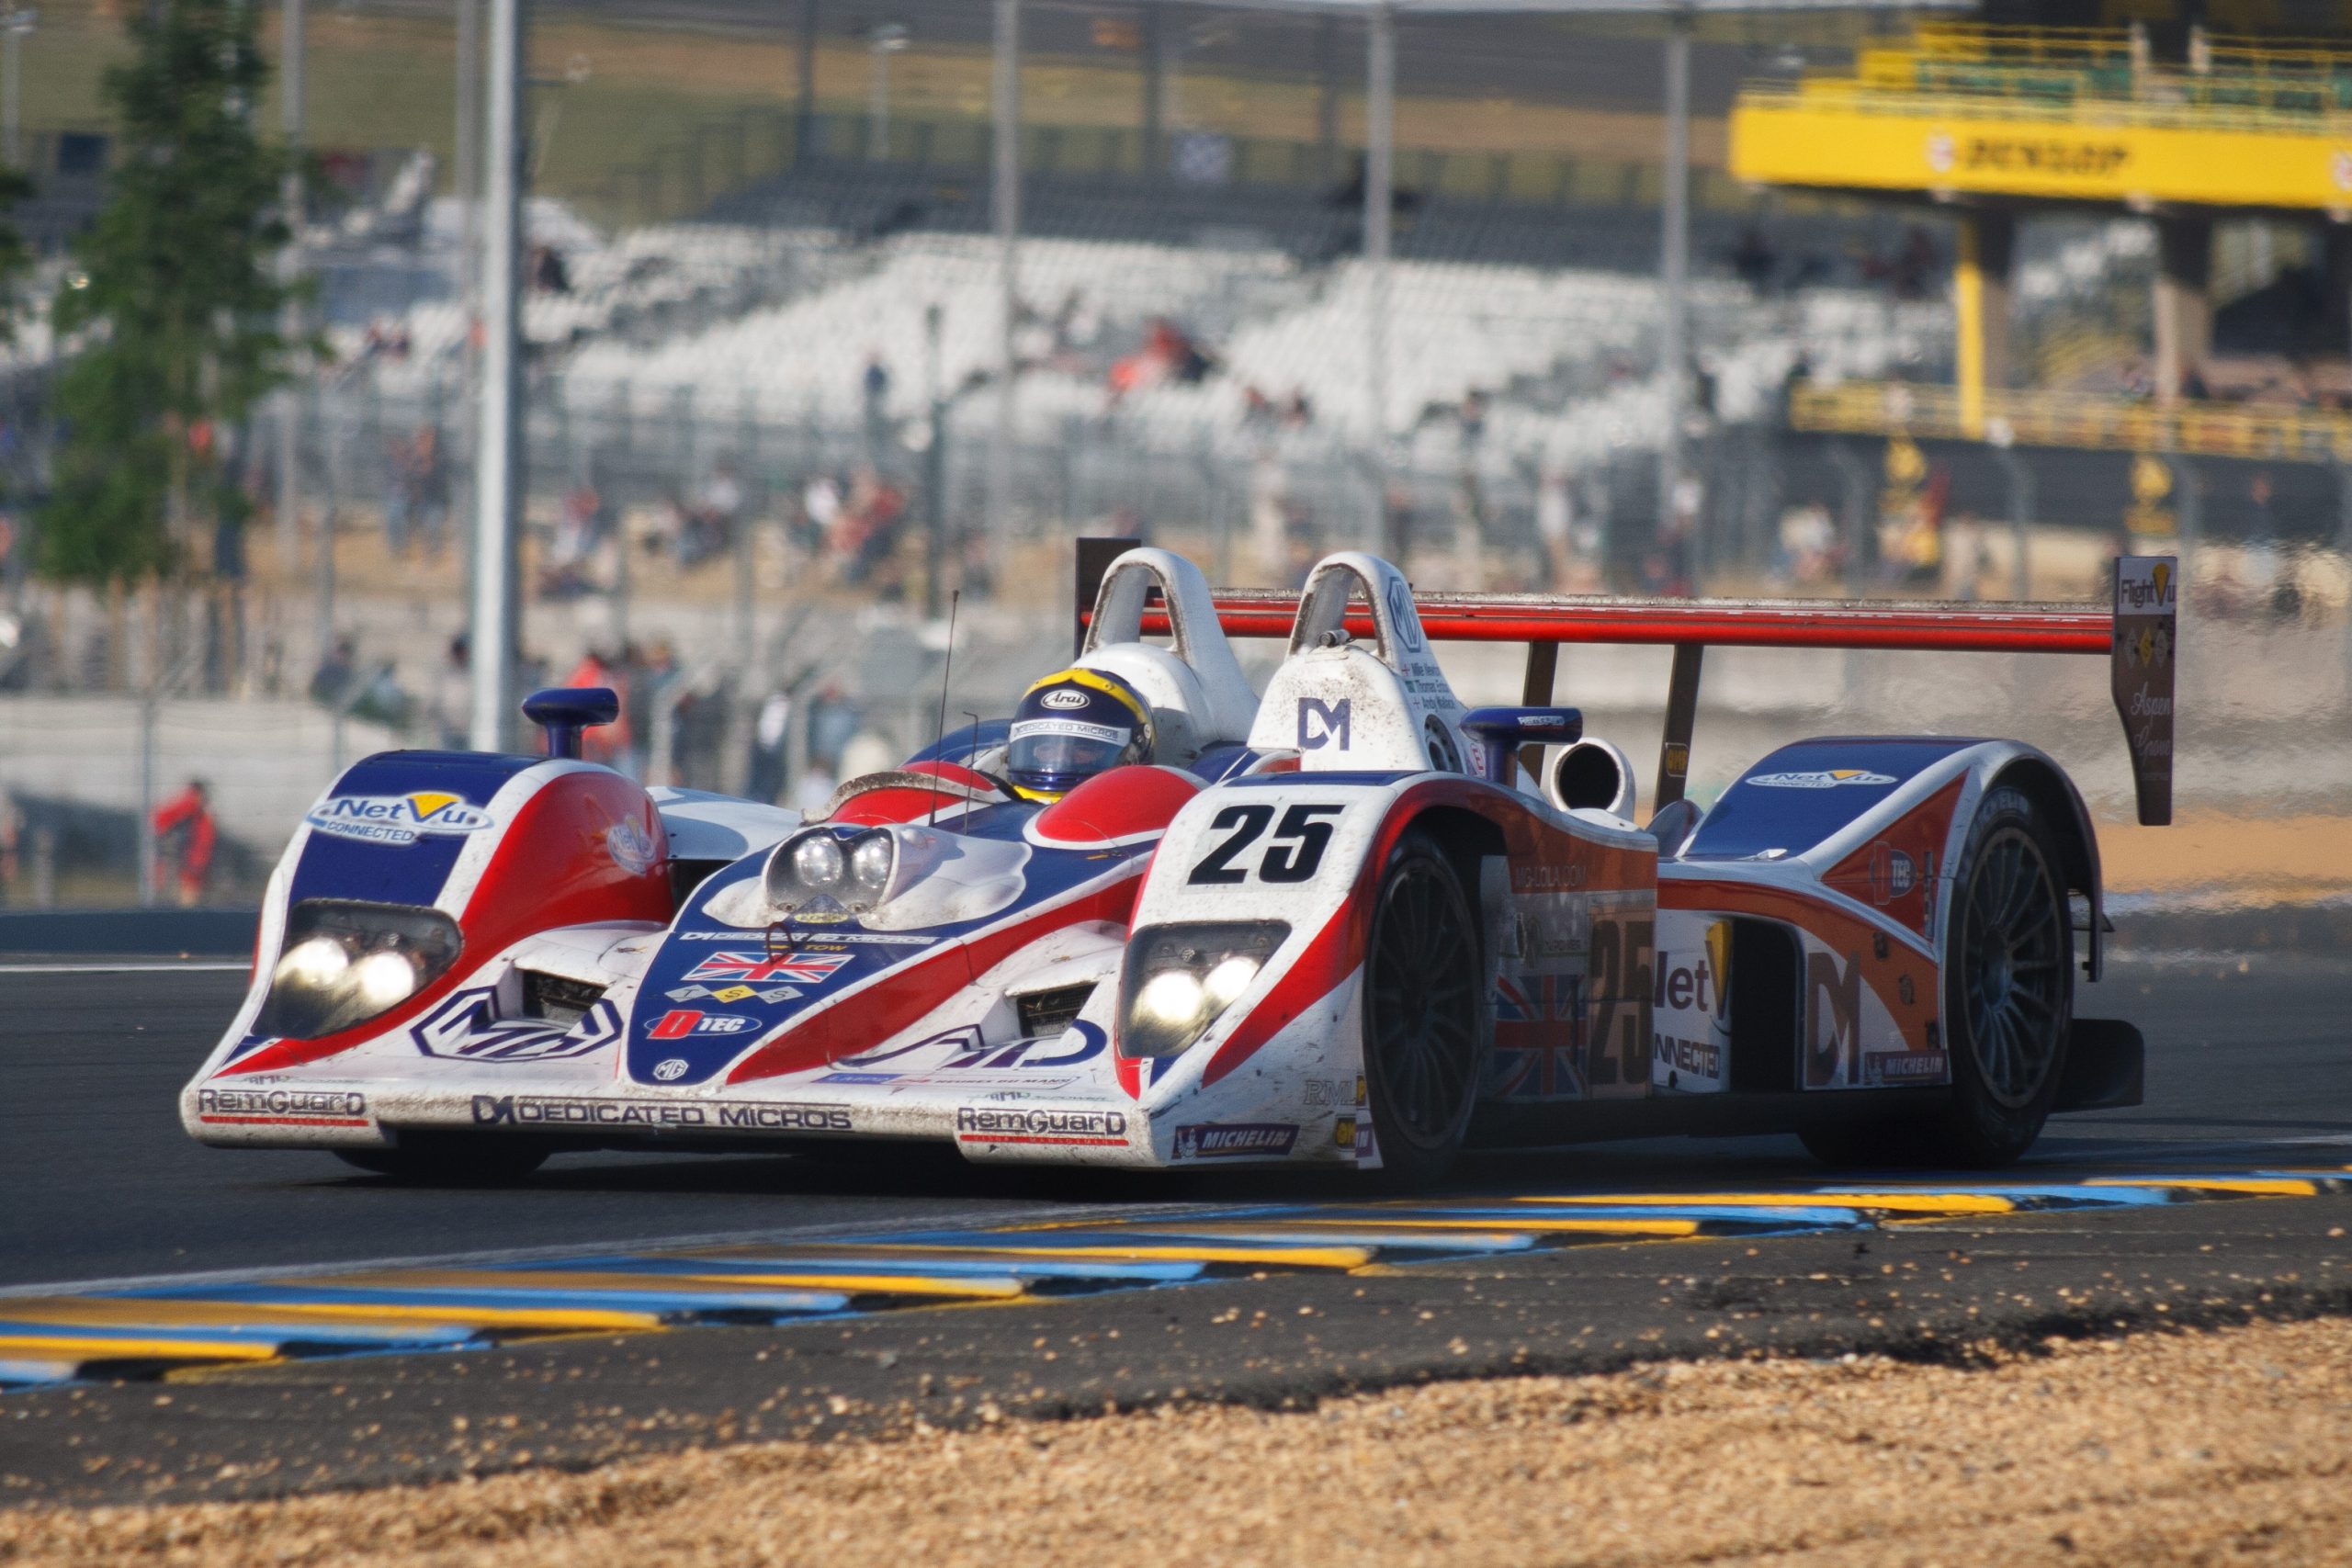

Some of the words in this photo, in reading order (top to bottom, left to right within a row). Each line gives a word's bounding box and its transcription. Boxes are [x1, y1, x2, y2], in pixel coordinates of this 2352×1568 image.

[1045, 693, 1082, 705] Arai
[1297, 697, 1351, 750] DM
[326, 820, 415, 842] CONNECTED
[1187, 805, 1347, 886] 25
[803, 943, 847, 952] TOW
[1589, 919, 1654, 1085] 25
[656, 1061, 685, 1079] MG
[1885, 1056, 1944, 1075] MICHELIN
[518, 1101, 705, 1125] DEDICATED
[719, 1107, 852, 1129] MICROS
[1202, 1129, 1291, 1148] MICHELIN
